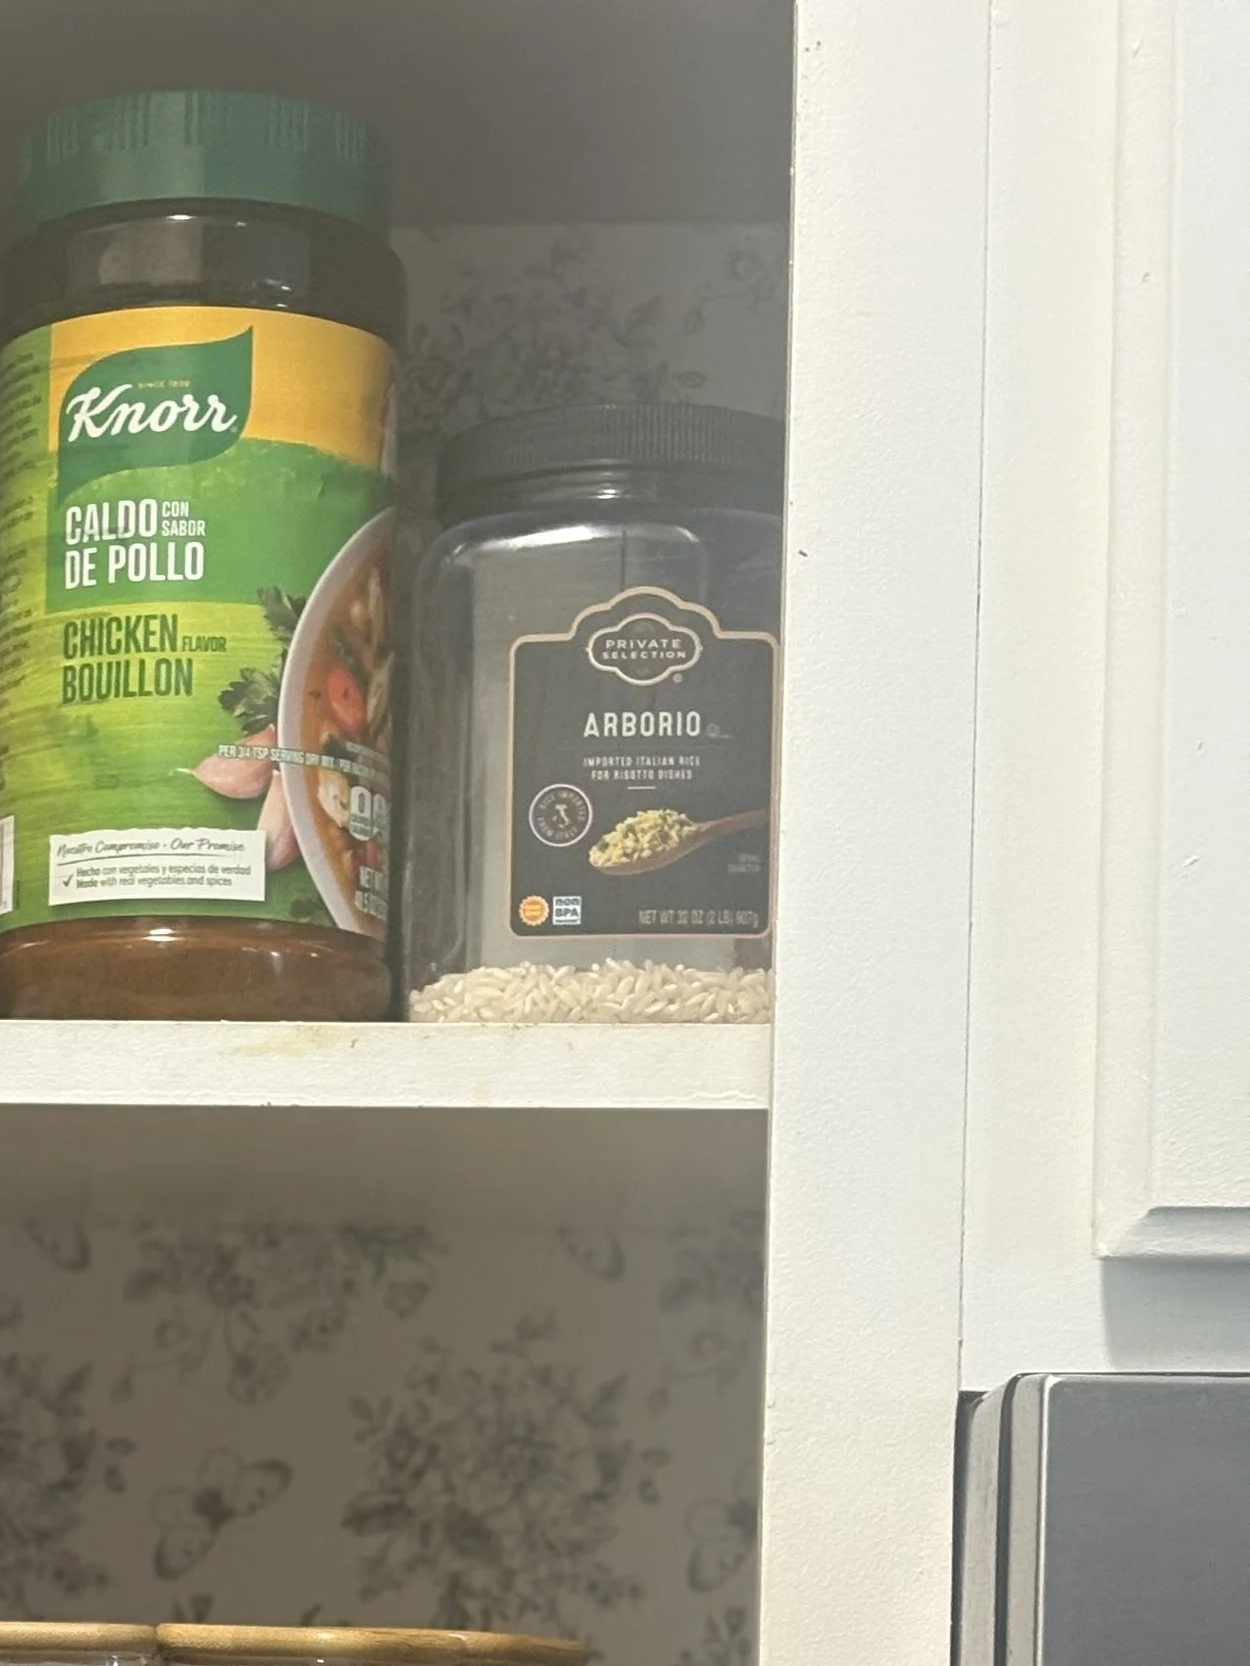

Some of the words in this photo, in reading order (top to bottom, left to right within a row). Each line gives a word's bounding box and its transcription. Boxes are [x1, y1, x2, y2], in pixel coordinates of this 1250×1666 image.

[66, 384, 237, 442] Knorr
[162, 501, 189, 518] CON
[66, 498, 158, 545] CALDO
[162, 520, 206, 537] SABOR
[65, 547, 97, 590] DE
[108, 541, 204, 584] POLLO
[63, 613, 178, 660] CHICKEN
[182, 635, 227, 652] FLAVOR
[606, 638, 682, 649] PRIVATE
[602, 651, 686, 660] SELECTION
[62, 658, 193, 705] BOUILLON
[583, 711, 700, 737] ARBORIO
[218, 745, 236, 758] PER
[583, 756, 632, 767] IMPORTED
[636, 756, 675, 766] ITALIAN
[679, 756, 700, 766] RICE
[591, 769, 609, 780] FOR
[614, 769, 655, 780] RISOTTO
[658, 769, 692, 780] DISHES
[170, 837, 194, 850] Our
[197, 838, 245, 852] Promise
[206, 876, 232, 888] spices
[555, 907, 579, 917] BPA
